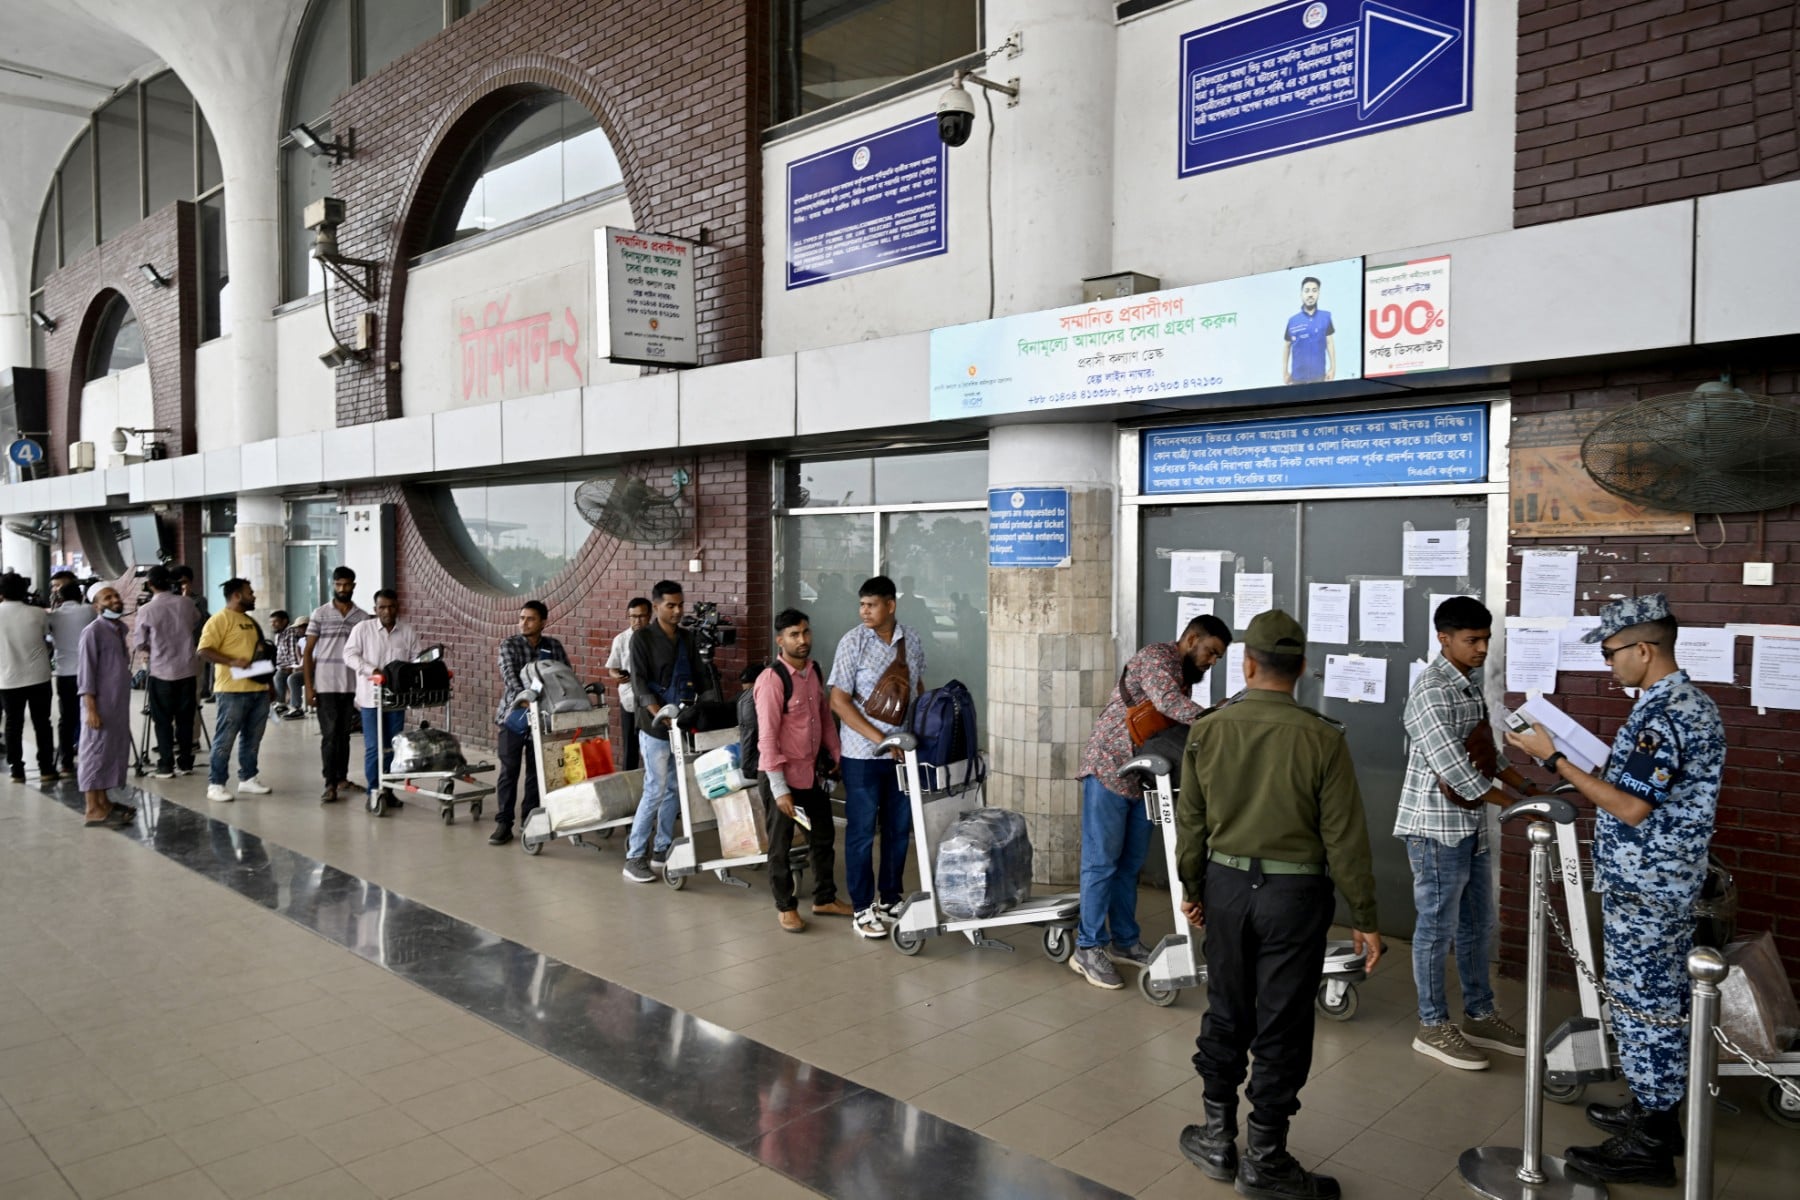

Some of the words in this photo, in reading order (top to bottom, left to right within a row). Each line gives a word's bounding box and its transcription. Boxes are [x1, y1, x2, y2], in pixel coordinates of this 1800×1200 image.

[1060, 308, 1112, 329] সম্মানিত
[1120, 297, 1182, 321] প্রবাসীগণ
[1369, 297, 1444, 340] ৩০%
[1018, 337, 1067, 356] বিনামূল্যে
[1073, 329, 1124, 346] আমাদের
[1130, 324, 1159, 341] সেবা
[1164, 318, 1194, 334] গ্রহণ
[1200, 312, 1237, 328] করুন
[1078, 352, 1104, 367] প্রবাসী
[1109, 352, 1138, 363] কল্যাণ
[1143, 348, 1164, 361] ডেস্ক
[1369, 345, 1391, 359] পর্যন্ত
[18, 444, 33, 461] 4
[1023, 507, 1055, 518] requested
[1057, 507, 1064, 515] to
[1011, 520, 1032, 530] printed
[1033, 519, 1042, 528] air
[1044, 519, 1063, 528] ticket
[1017, 532, 1033, 541] while
[1035, 531, 1064, 542] entering
[1619, 772, 1653, 797] বিমান
[1567, 856, 1578, 887] 3279
